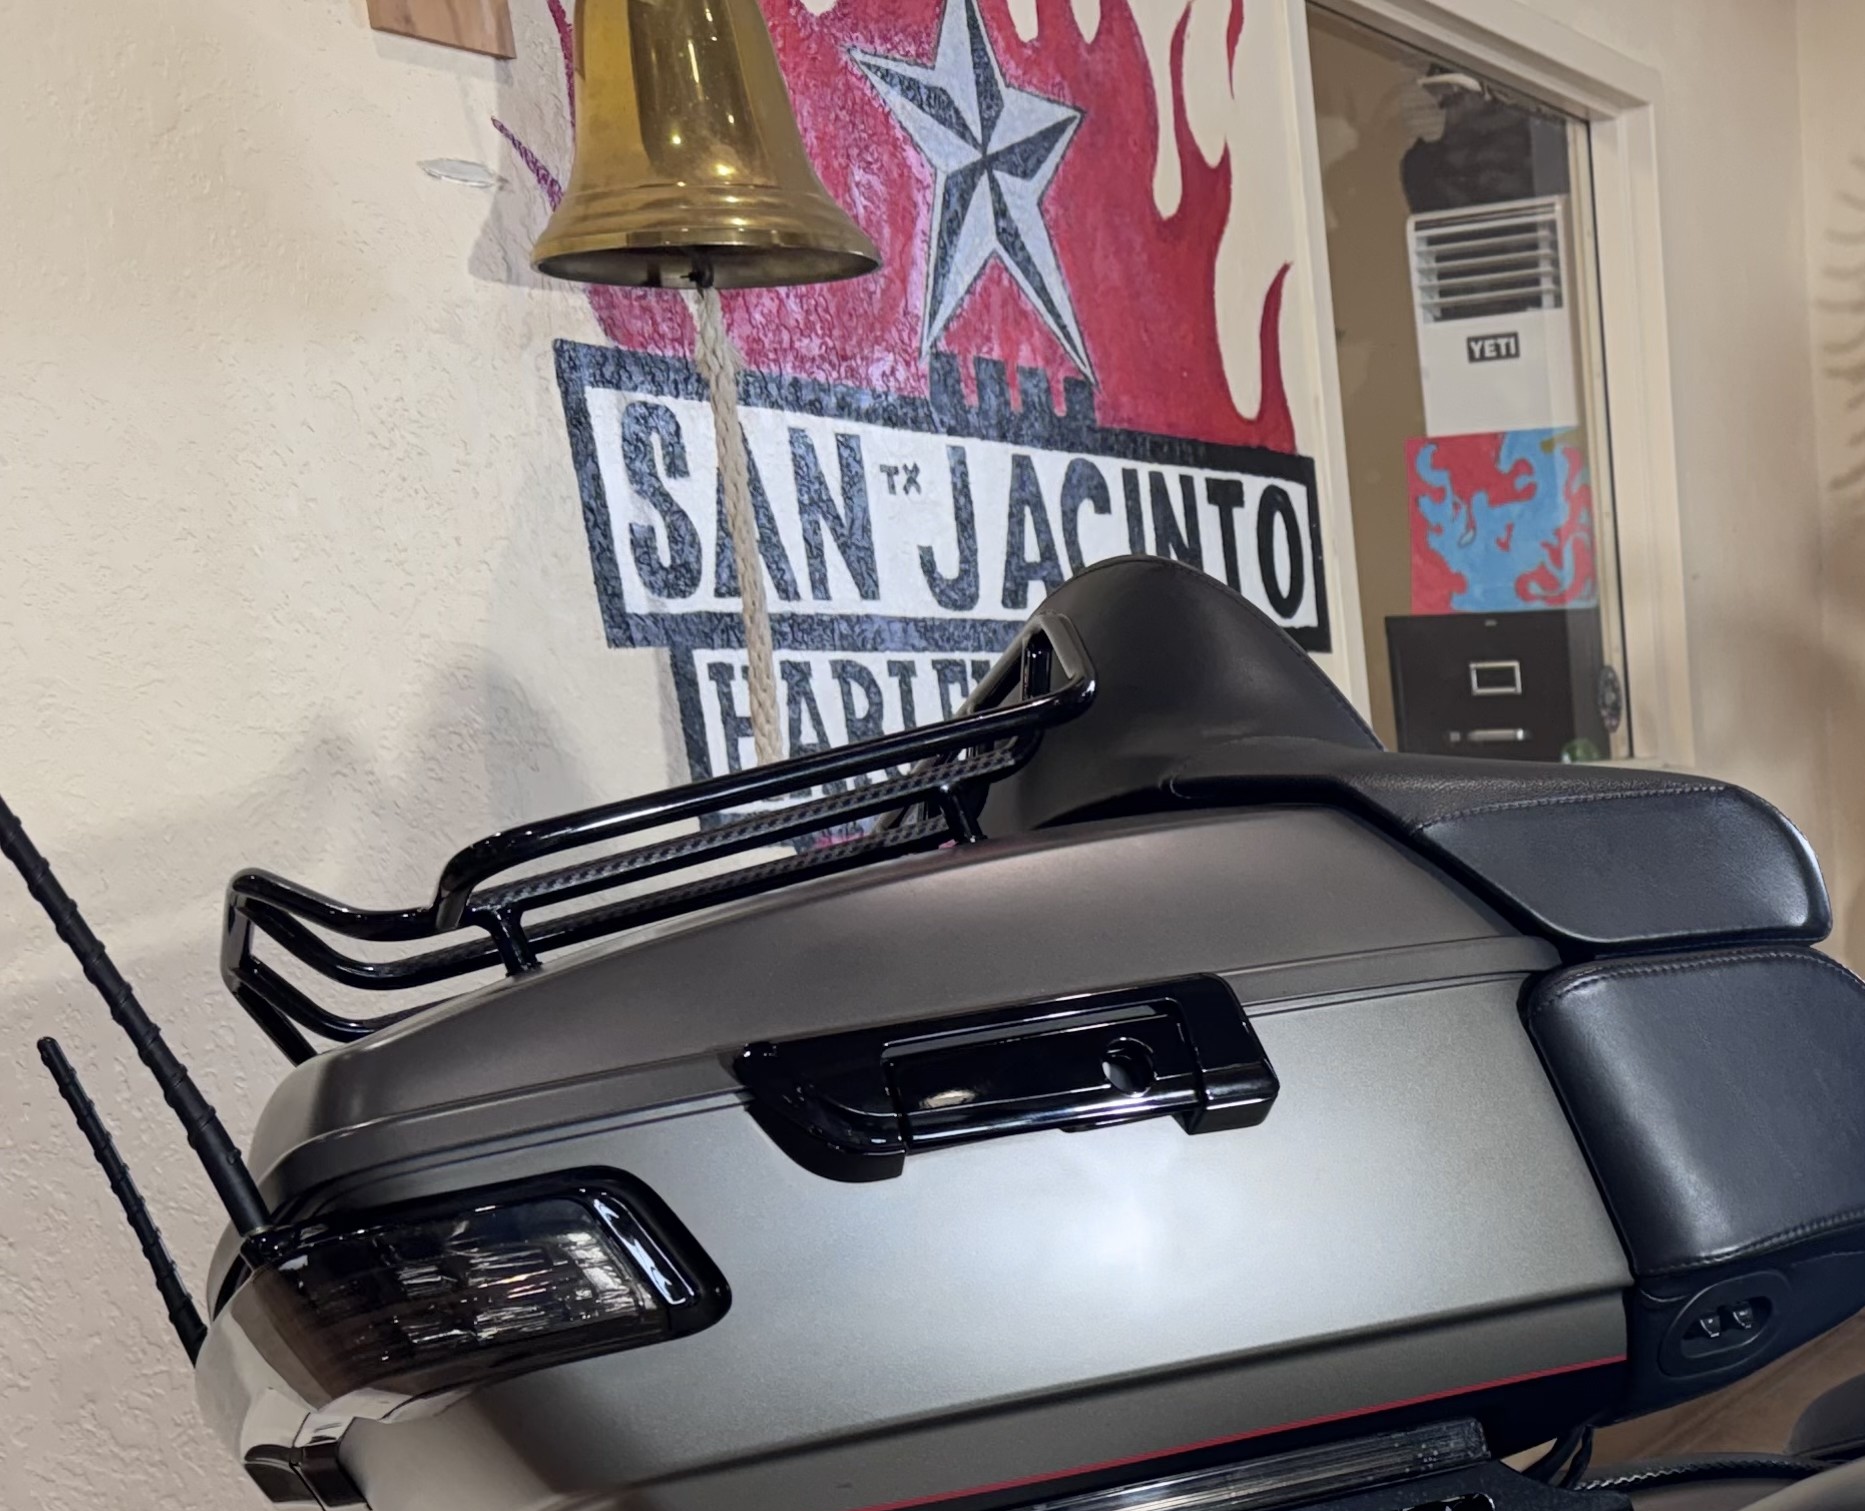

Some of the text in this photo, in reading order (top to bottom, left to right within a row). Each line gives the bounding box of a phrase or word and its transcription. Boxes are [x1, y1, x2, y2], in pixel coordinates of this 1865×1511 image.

[1470, 336, 1517, 359] YETI
[621, 400, 1305, 620] SAN TX JACINTO
